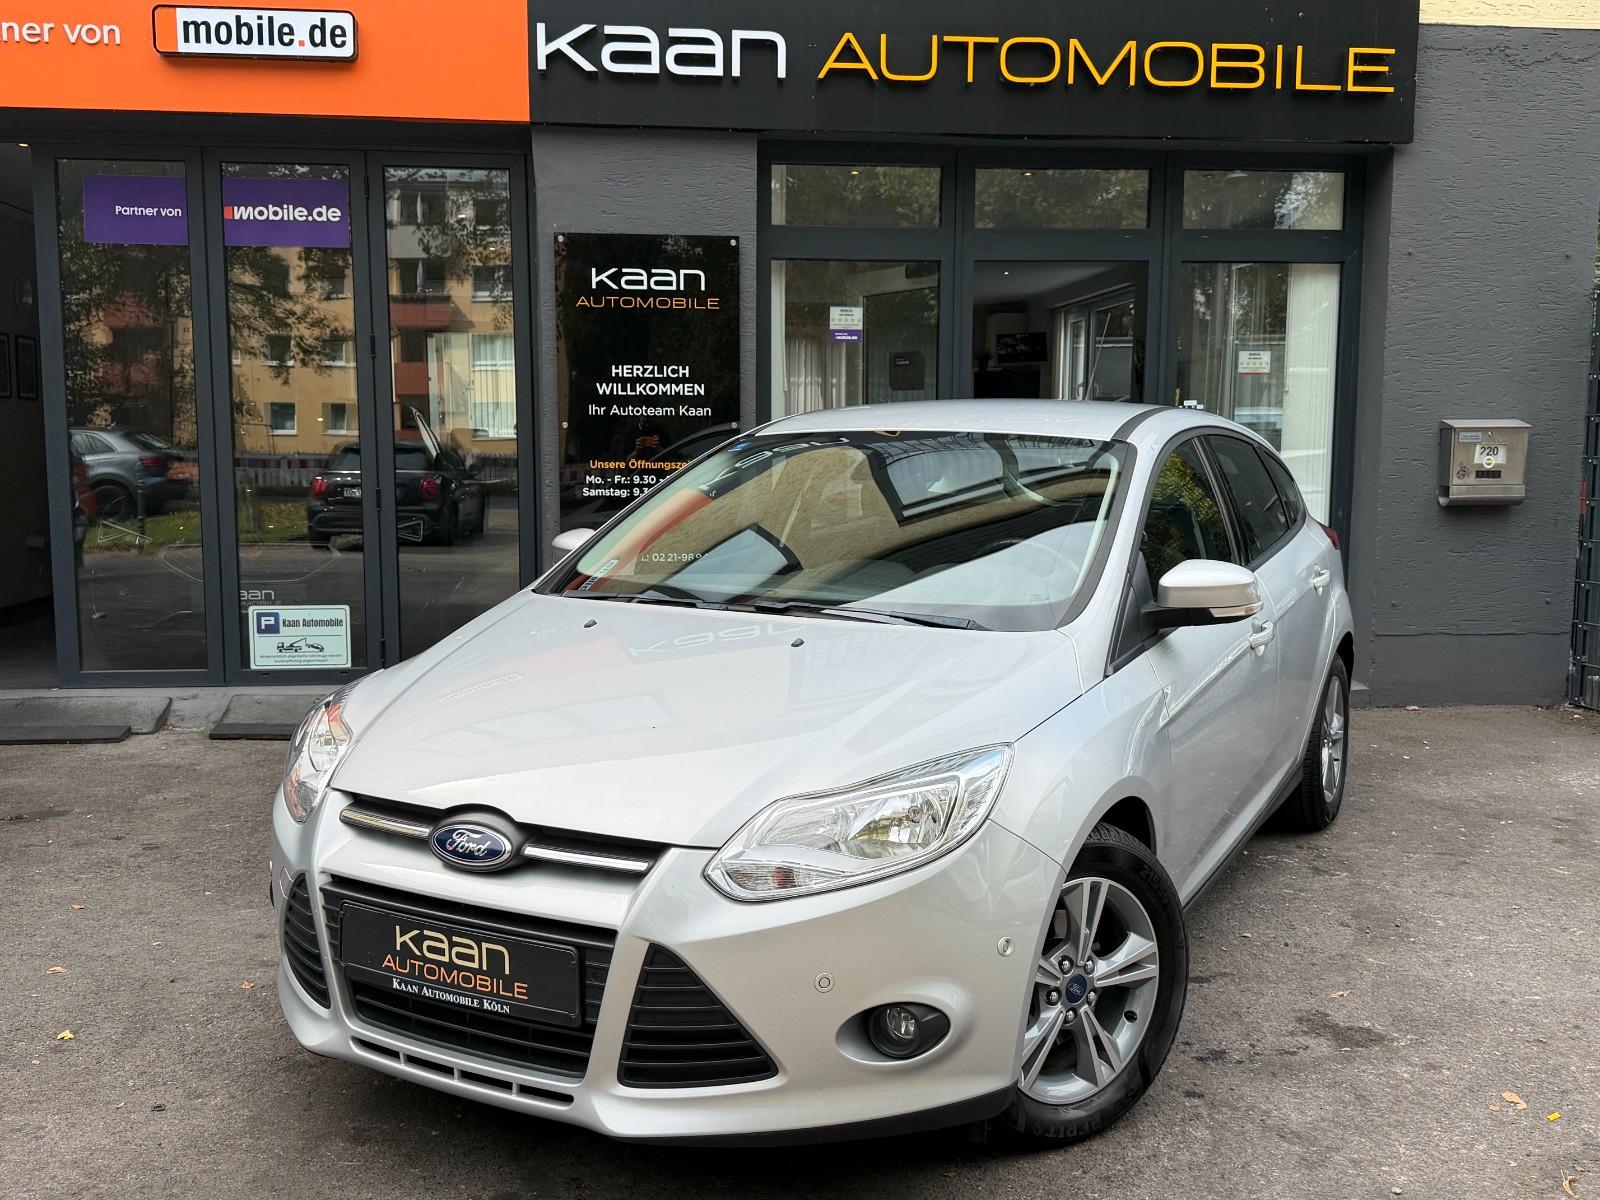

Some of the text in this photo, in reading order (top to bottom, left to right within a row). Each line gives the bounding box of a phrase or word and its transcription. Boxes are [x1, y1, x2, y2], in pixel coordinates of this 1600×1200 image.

[63, 23, 121, 45] von
[182, 15, 347, 48] mobile.de
[817, 32, 1396, 94] AUTOMOBILE
[115, 205, 183, 217] Partner von
[233, 204, 342, 223] mobile.de
[576, 296, 720, 310] AUTOMOBILE
[611, 365, 690, 378] HERZLICH
[596, 382, 705, 396] WILLKOMMEN
[588, 404, 712, 417] Ihr Autoteam Kaan
[1480, 446, 1499, 456] 220
[589, 458, 690, 470] Unsere Öffnungsze
[585, 475, 604, 484] Mo.
[614, 475, 630, 484] Fr.:
[633, 475, 656, 484] 9.30
[582, 487, 649, 498] Samstag: 9.3
[282, 618, 300, 627] Kaan
[302, 618, 344, 628] Automobile
[446, 829, 490, 857] Ford
[382, 954, 529, 1000] AUTOMOBILE
